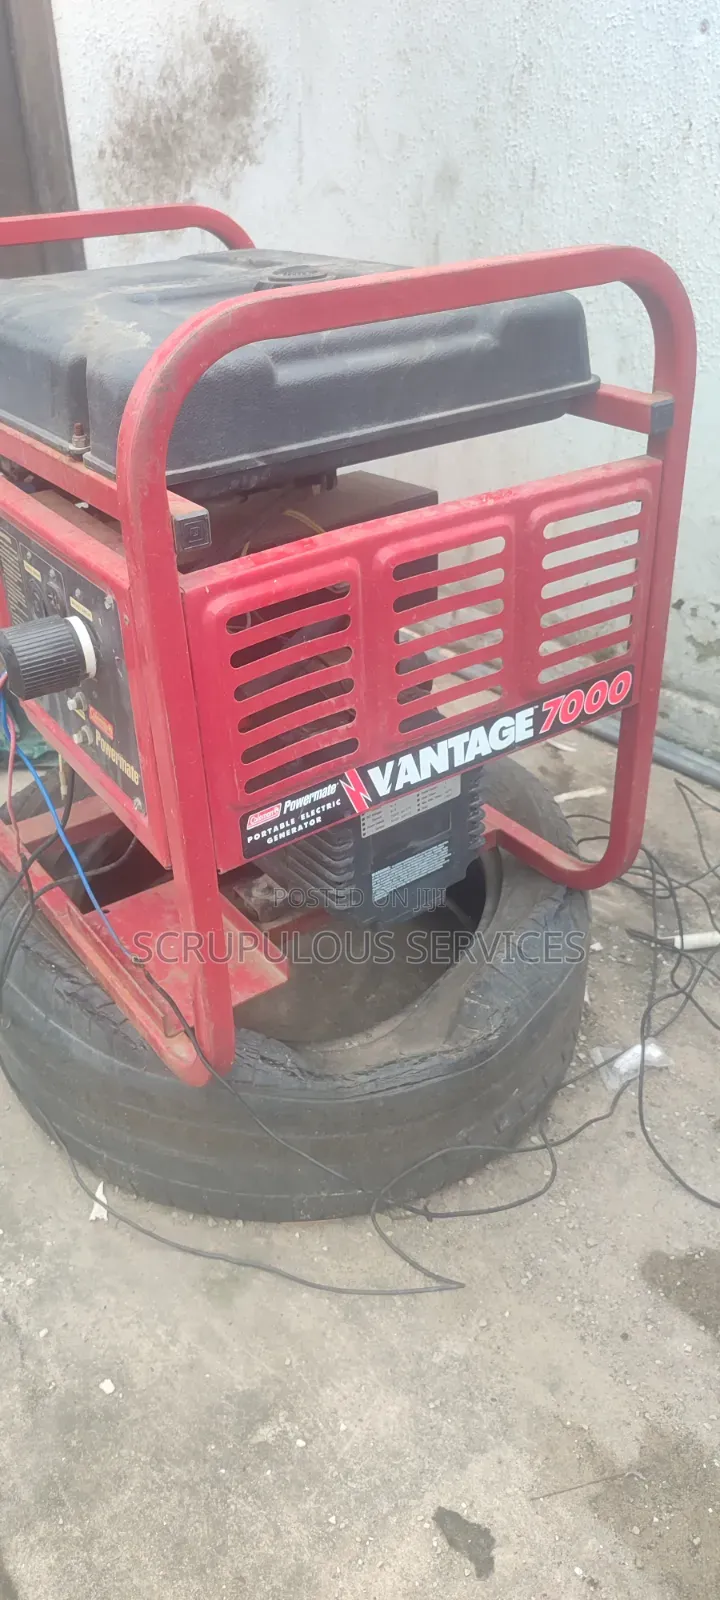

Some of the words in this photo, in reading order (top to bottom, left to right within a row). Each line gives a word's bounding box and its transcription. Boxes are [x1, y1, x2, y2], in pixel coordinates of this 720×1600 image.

[367, 707, 534, 797] VANTAGE
[539, 671, 632, 734] 7000
[95, 729, 139, 785] Powermate
[283, 783, 338, 814] Powermate
[247, 818, 295, 843] PORTABLE
[301, 799, 341, 820] ELECTRIC
[267, 816, 322, 844] GENERATOR
